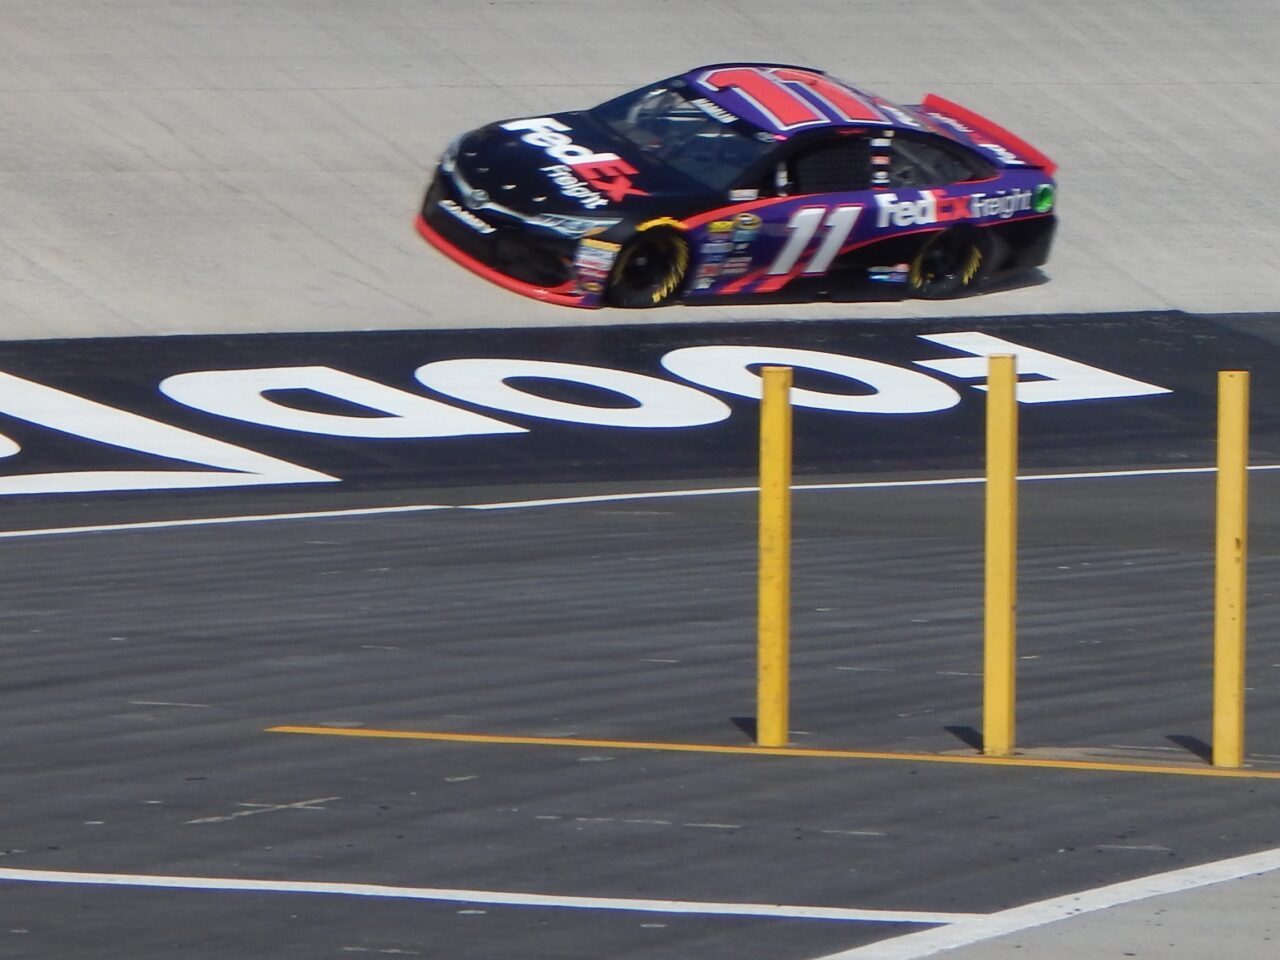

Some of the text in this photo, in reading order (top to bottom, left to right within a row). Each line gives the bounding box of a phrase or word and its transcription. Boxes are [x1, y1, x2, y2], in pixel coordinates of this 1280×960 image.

[698, 67, 894, 132] 11
[500, 117, 651, 203] FedEx
[765, 205, 864, 276] 11
[874, 188, 1033, 228] FedEx Freight
